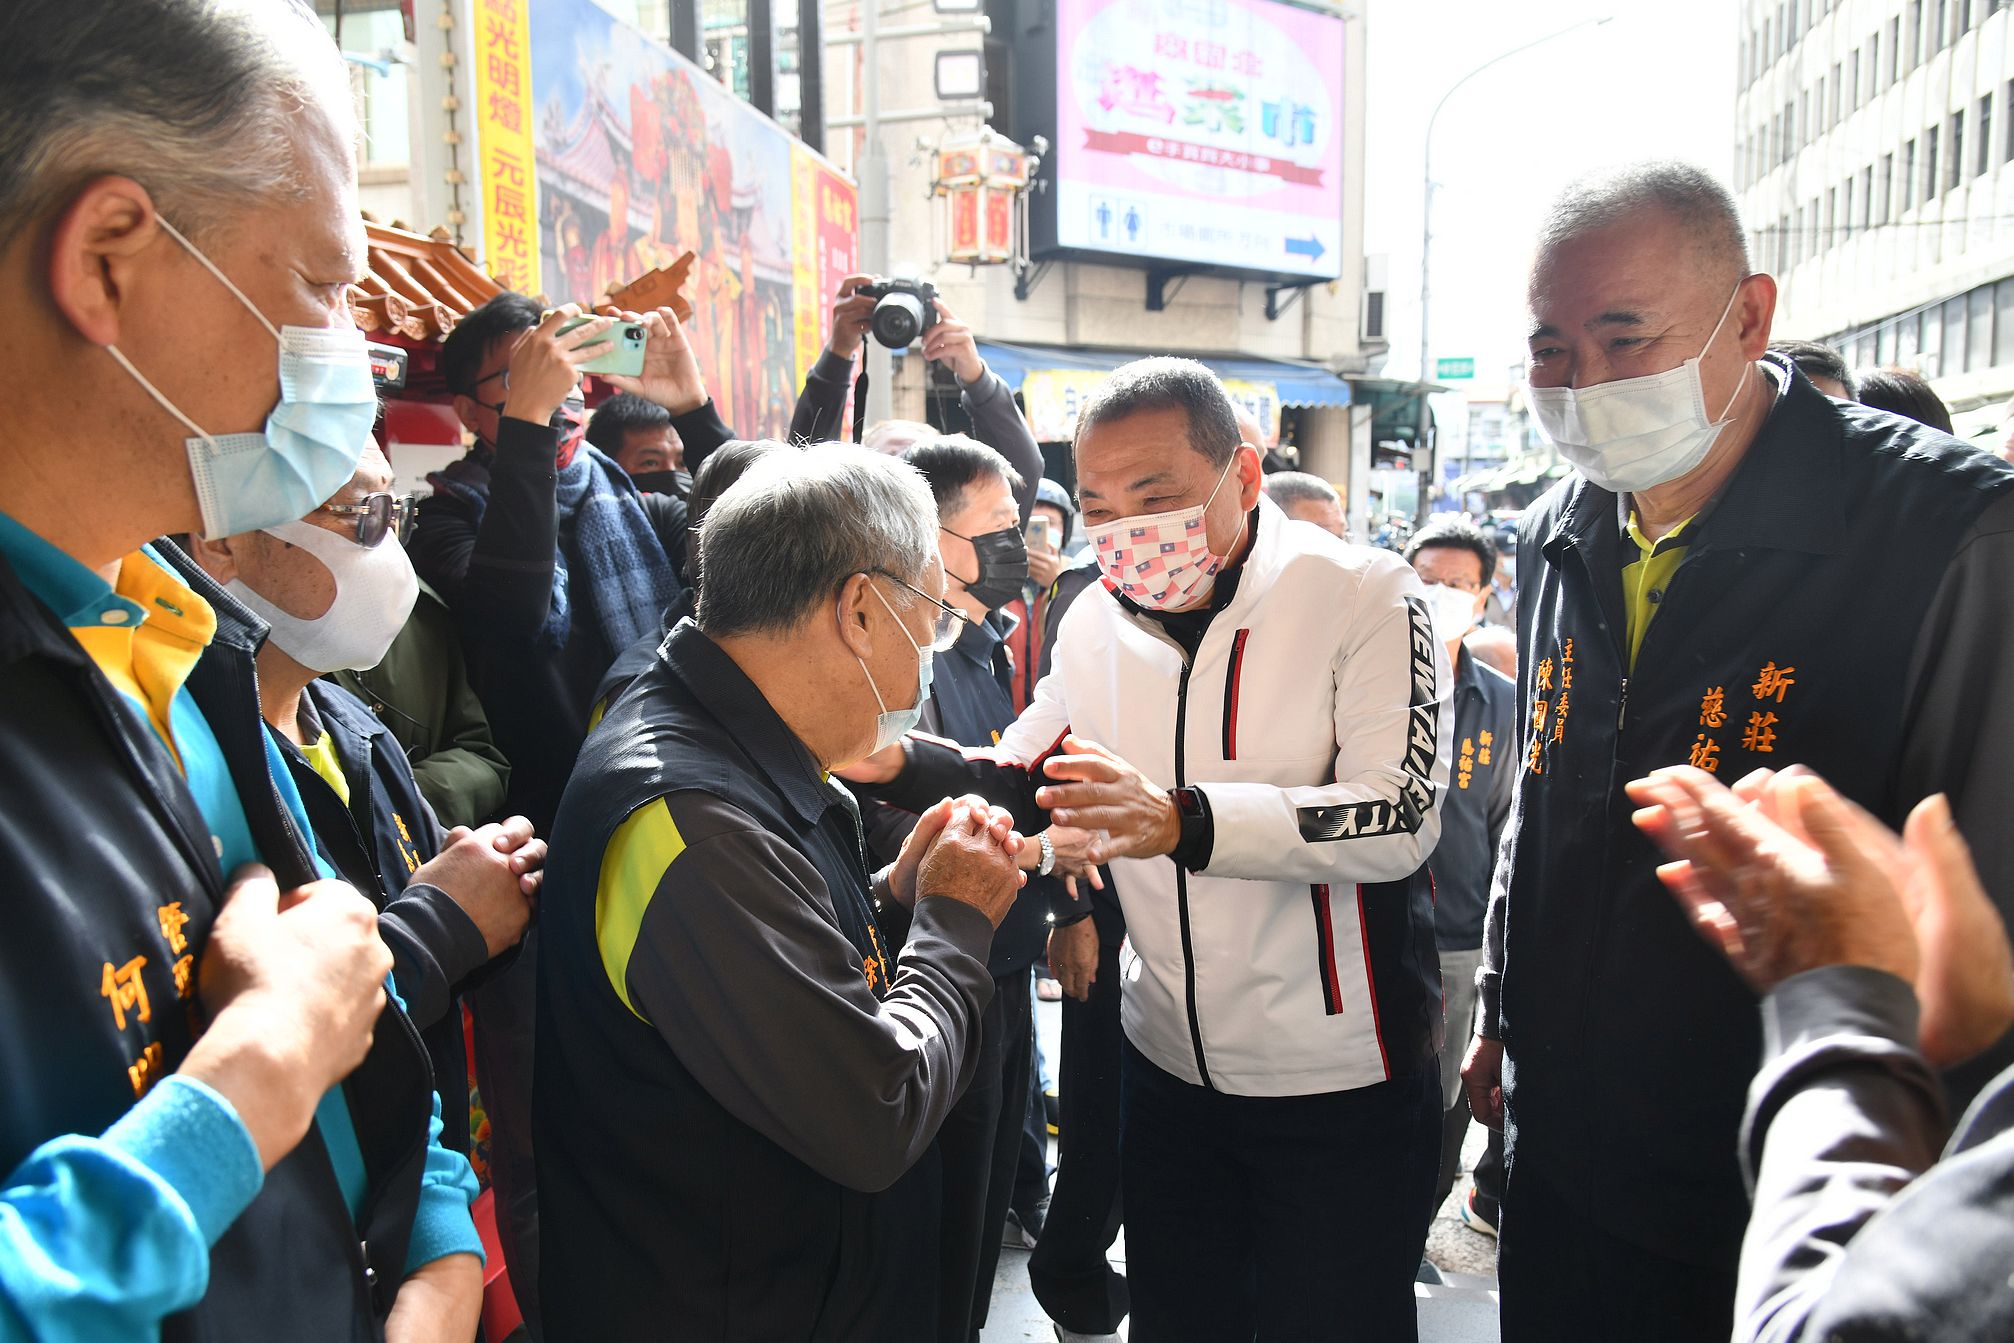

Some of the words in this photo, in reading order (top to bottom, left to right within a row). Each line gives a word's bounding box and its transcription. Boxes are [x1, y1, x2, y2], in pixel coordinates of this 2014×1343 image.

[1411, 601, 1437, 702] NEW
[1553, 637, 1575, 745] 主任委員
[1527, 656, 1555, 776] 陳圓光
[1742, 660, 1798, 753] 新莊
